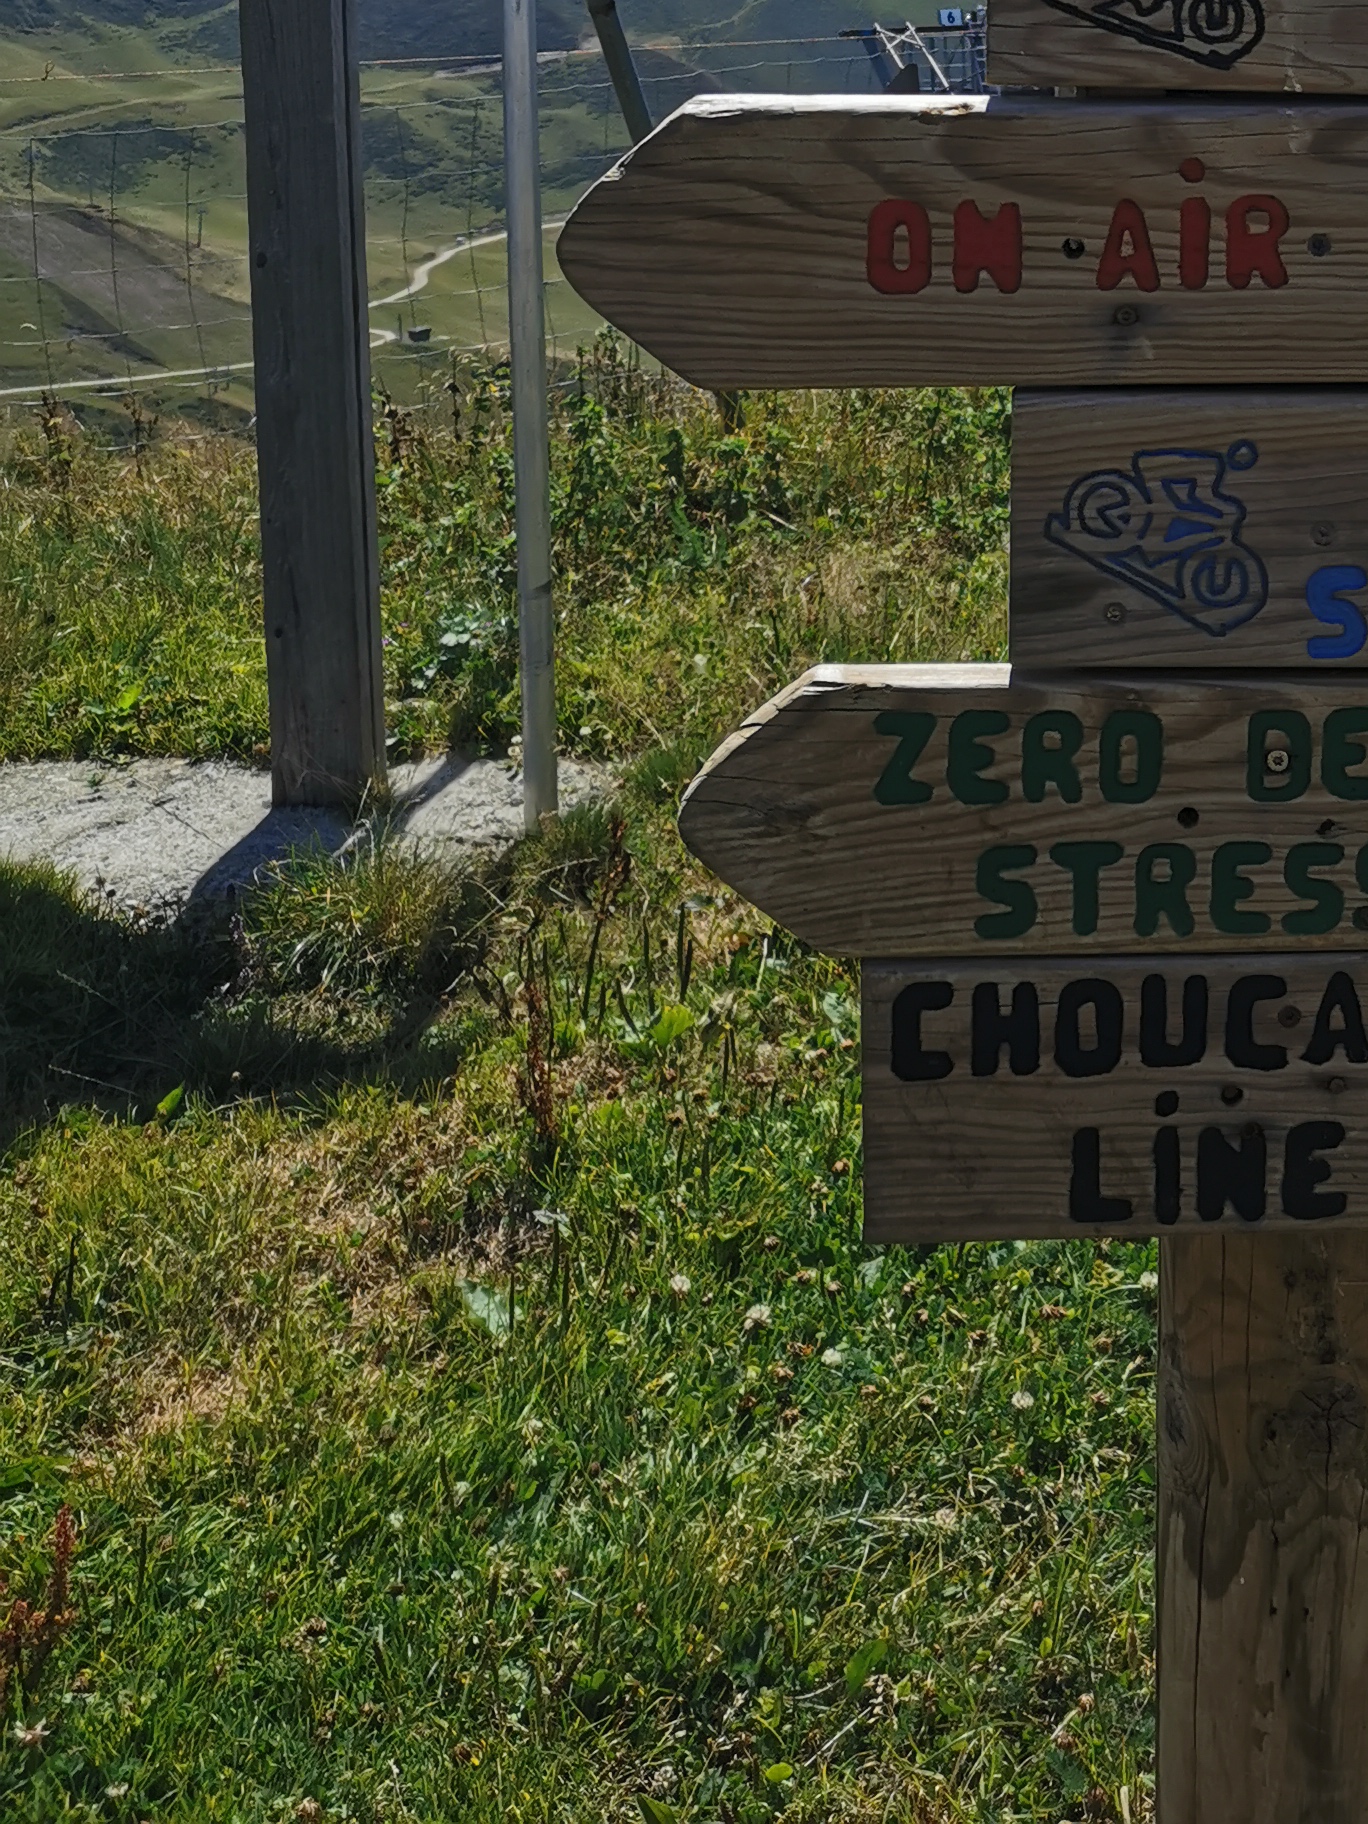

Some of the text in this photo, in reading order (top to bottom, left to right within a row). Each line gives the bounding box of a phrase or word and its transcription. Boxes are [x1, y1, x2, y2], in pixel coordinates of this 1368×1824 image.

[946, 11, 955, 24] 6
[865, 197, 1024, 296] ON
[872, 708, 1166, 806] ZERO
